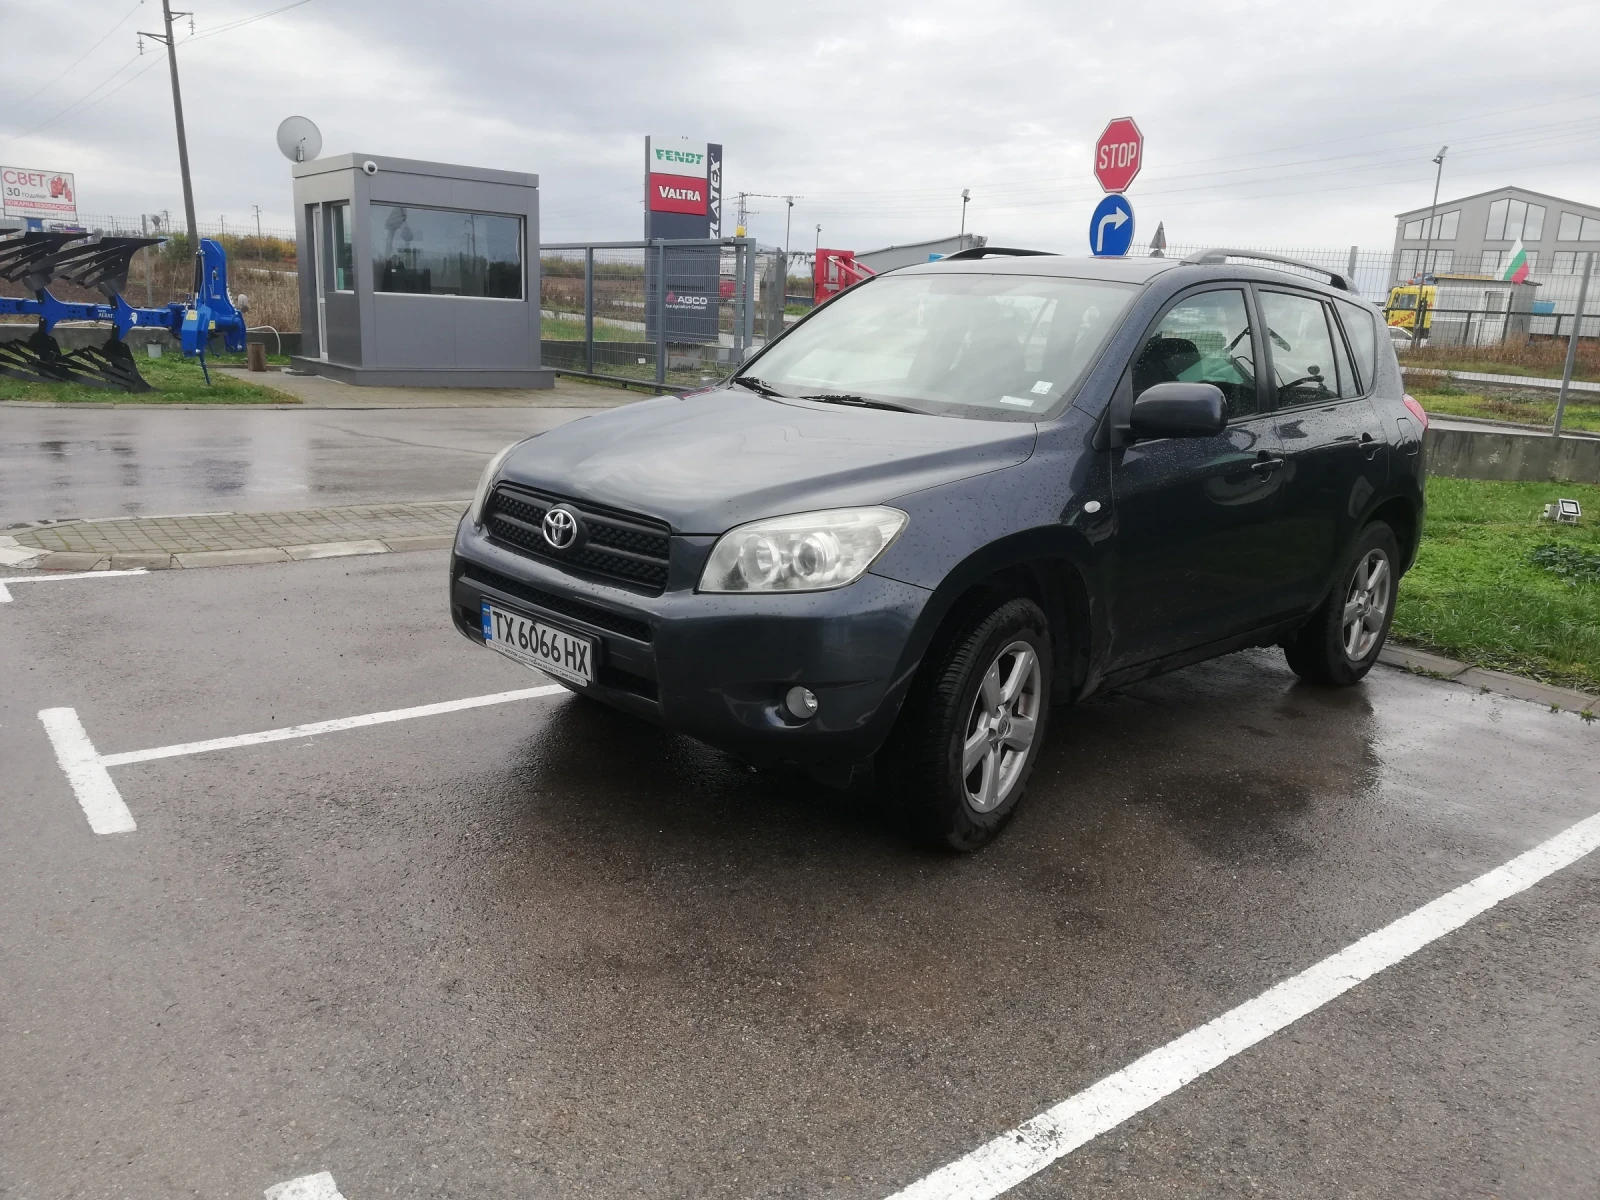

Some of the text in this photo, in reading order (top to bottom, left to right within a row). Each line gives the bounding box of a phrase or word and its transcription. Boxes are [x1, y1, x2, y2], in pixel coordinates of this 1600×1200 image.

[655, 148, 704, 165] FENDT
[1098, 141, 1137, 170] STOP
[3, 170, 46, 187] СВЕТ
[6, 187, 21, 197] 30
[658, 185, 701, 201] VALTRA
[677, 296, 708, 305] AGCO
[483, 624, 492, 635] BG
[518, 621, 562, 663] 6066
[564, 637, 589, 676] HX
